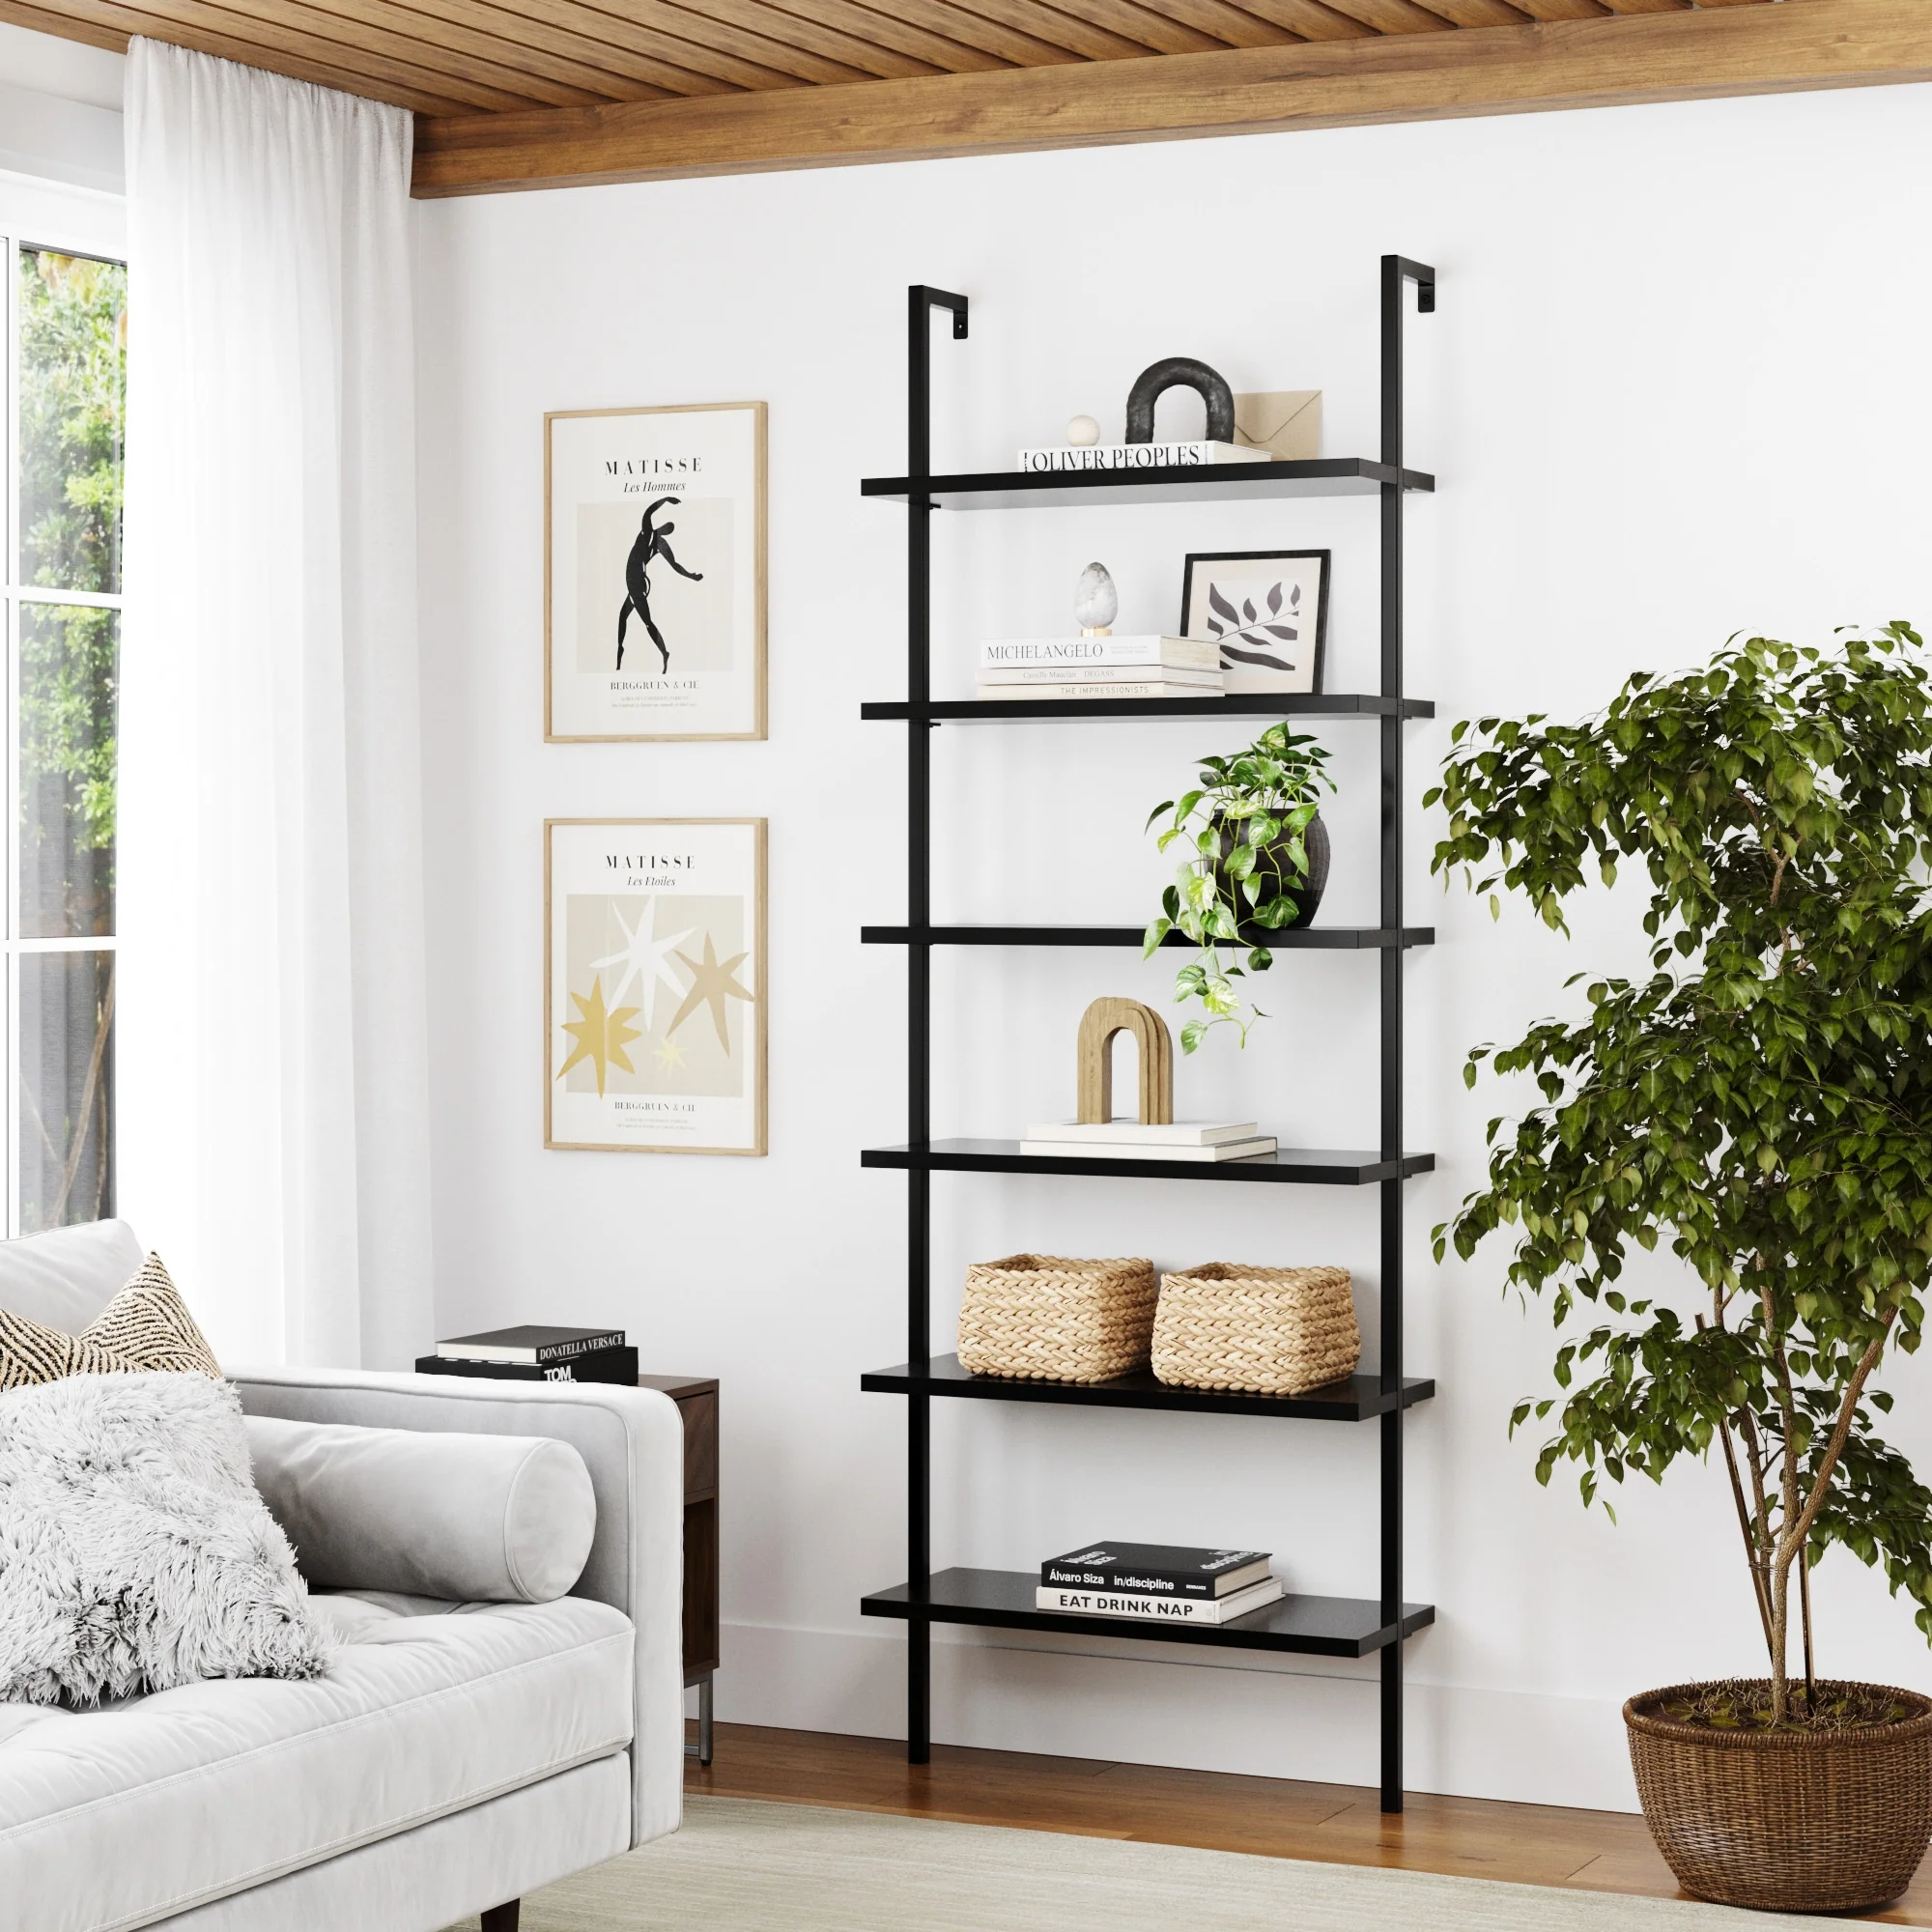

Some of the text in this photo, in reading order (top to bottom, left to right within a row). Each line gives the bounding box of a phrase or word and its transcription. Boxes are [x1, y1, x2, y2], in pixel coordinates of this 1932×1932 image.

[605, 457, 702, 475] MATISSE
[1033, 445, 1200, 472] OLIVER PEOPLES
[623, 481, 687, 494] Les Hommes
[986, 643, 1104, 660] MICHELANGELO
[1084, 669, 1115, 678] DEGASS
[611, 680, 669, 691] BERGGRUEN
[672, 680, 680, 690] &
[1079, 685, 1150, 695] IMPRESSIONISTS
[605, 855, 696, 869] MATISSE
[627, 876, 643, 886] Les
[614, 1101, 669, 1112] BERGGRUEN
[672, 1103, 679, 1112] &
[540, 1333, 623, 1360] DONATELLA VERSACE
[544, 1365, 572, 1382] TOM
[1049, 1569, 1082, 1583] Álvaro
[1083, 1573, 1105, 1585] Siza
[1114, 1576, 1175, 1591] in/discipline
[1060, 1594, 1194, 1617] EAT DRINK NAP
